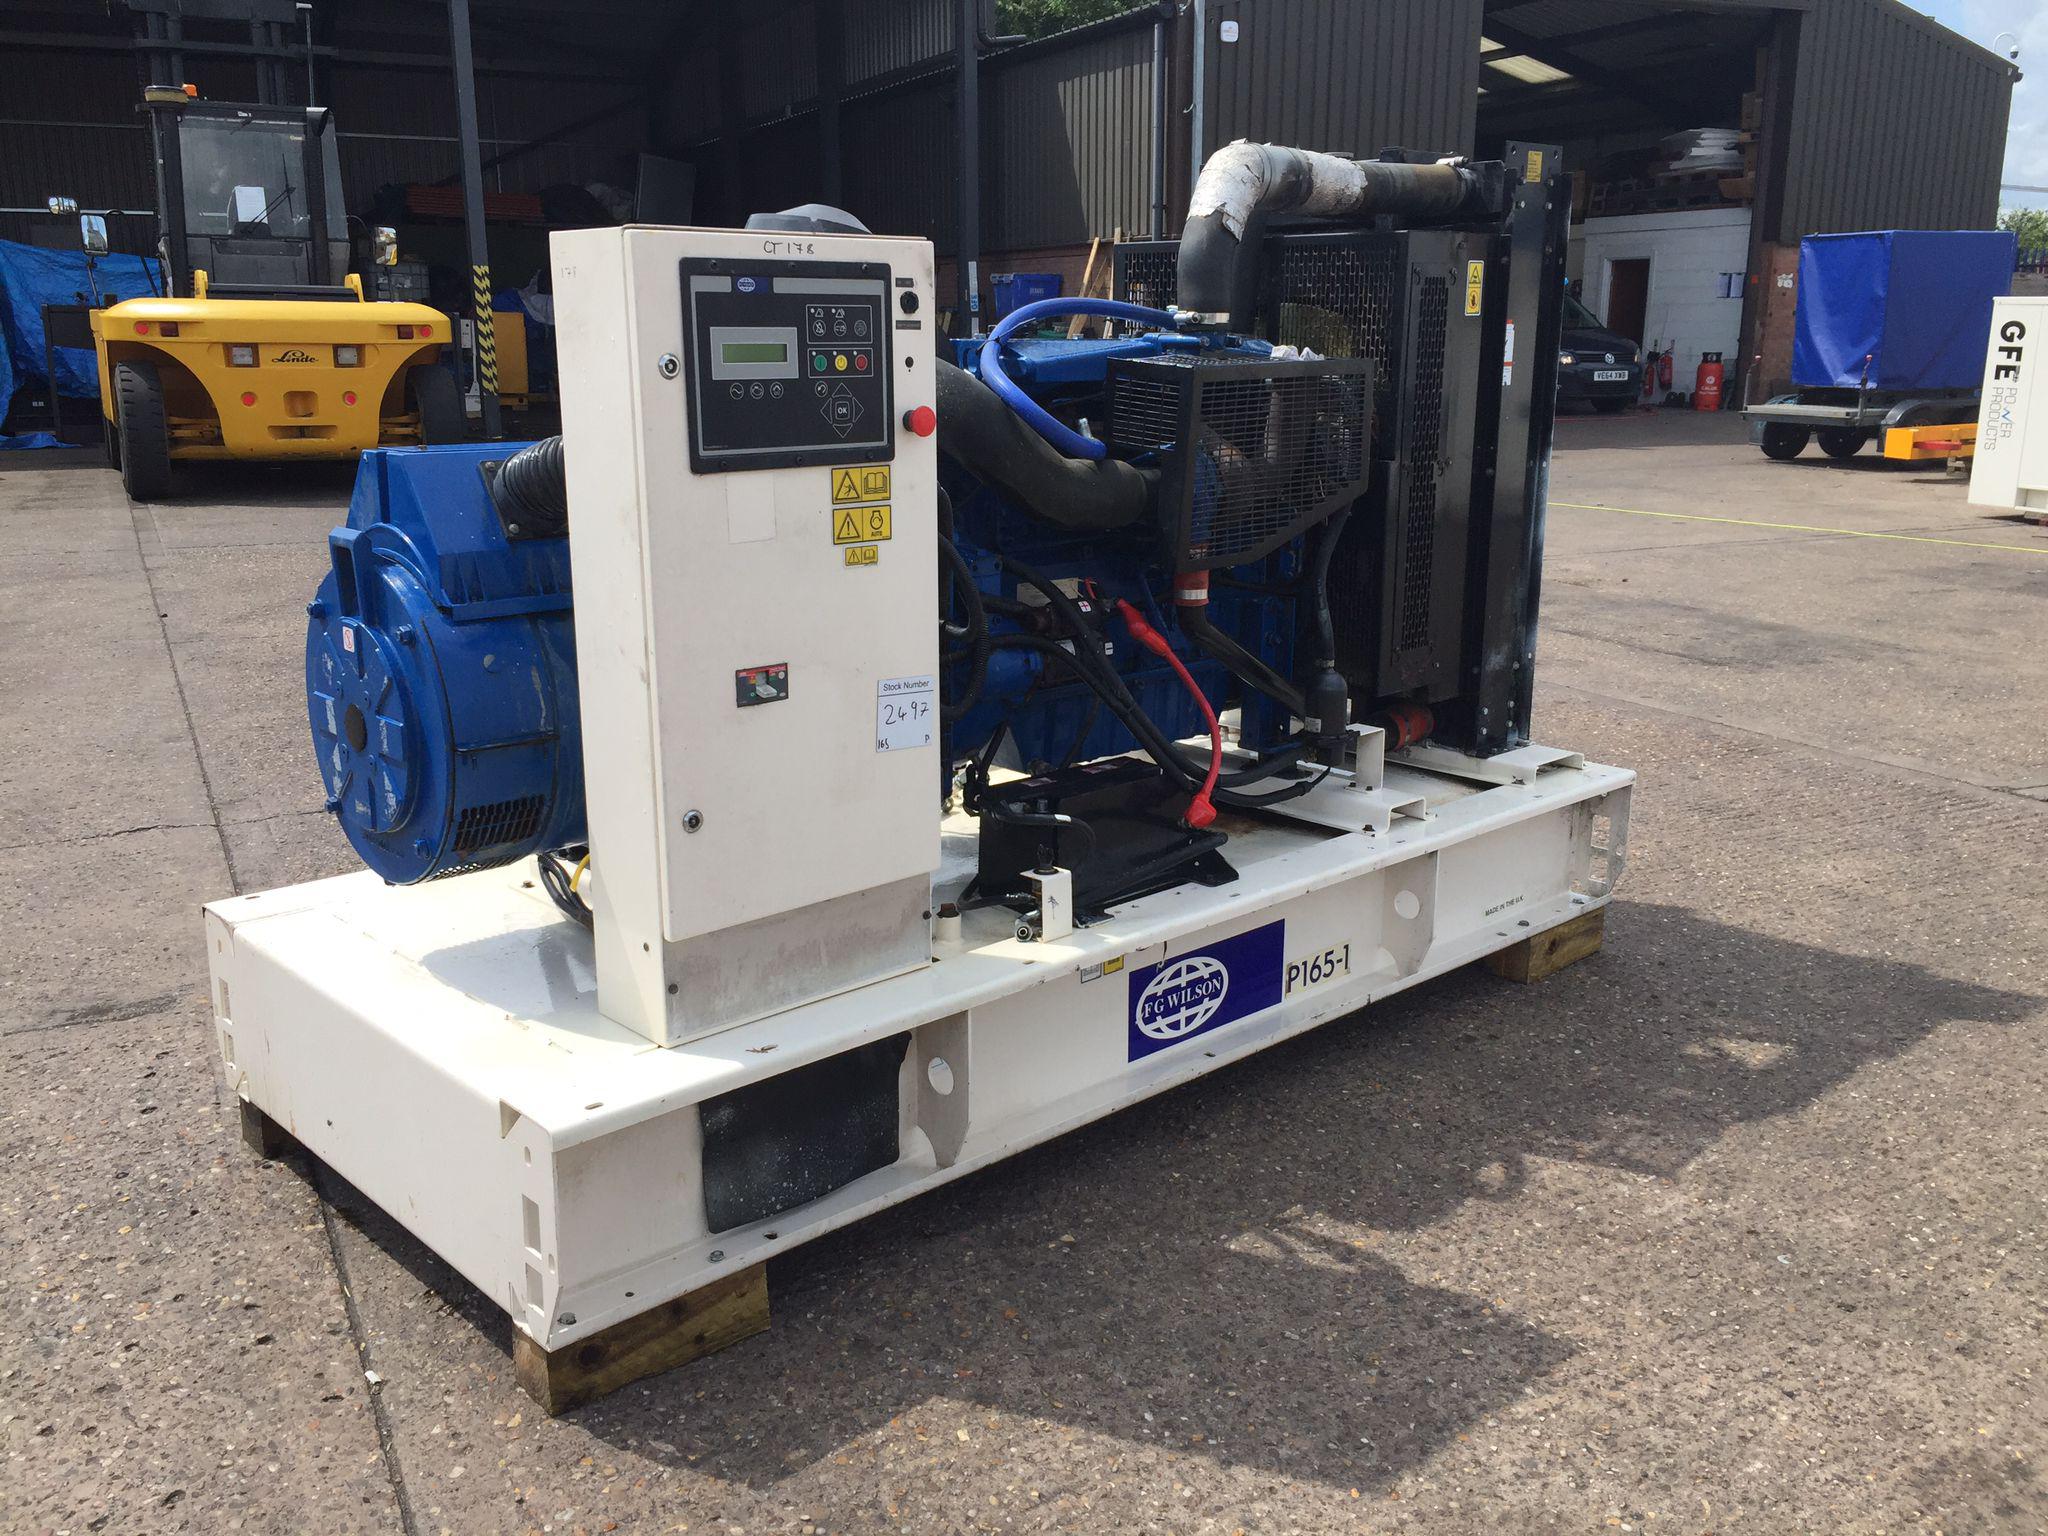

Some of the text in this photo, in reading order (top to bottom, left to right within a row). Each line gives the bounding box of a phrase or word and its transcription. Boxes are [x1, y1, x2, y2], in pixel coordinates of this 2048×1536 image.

[271, 349, 319, 363] Linde
[1994, 320, 2026, 381] GFE
[1984, 386, 2004, 451] PRODUCTS
[883, 680, 930, 692] Stock Number
[883, 701, 929, 725] 2497
[1286, 944, 1350, 993] P165-1
[1167, 977, 1221, 1009] WILSON
